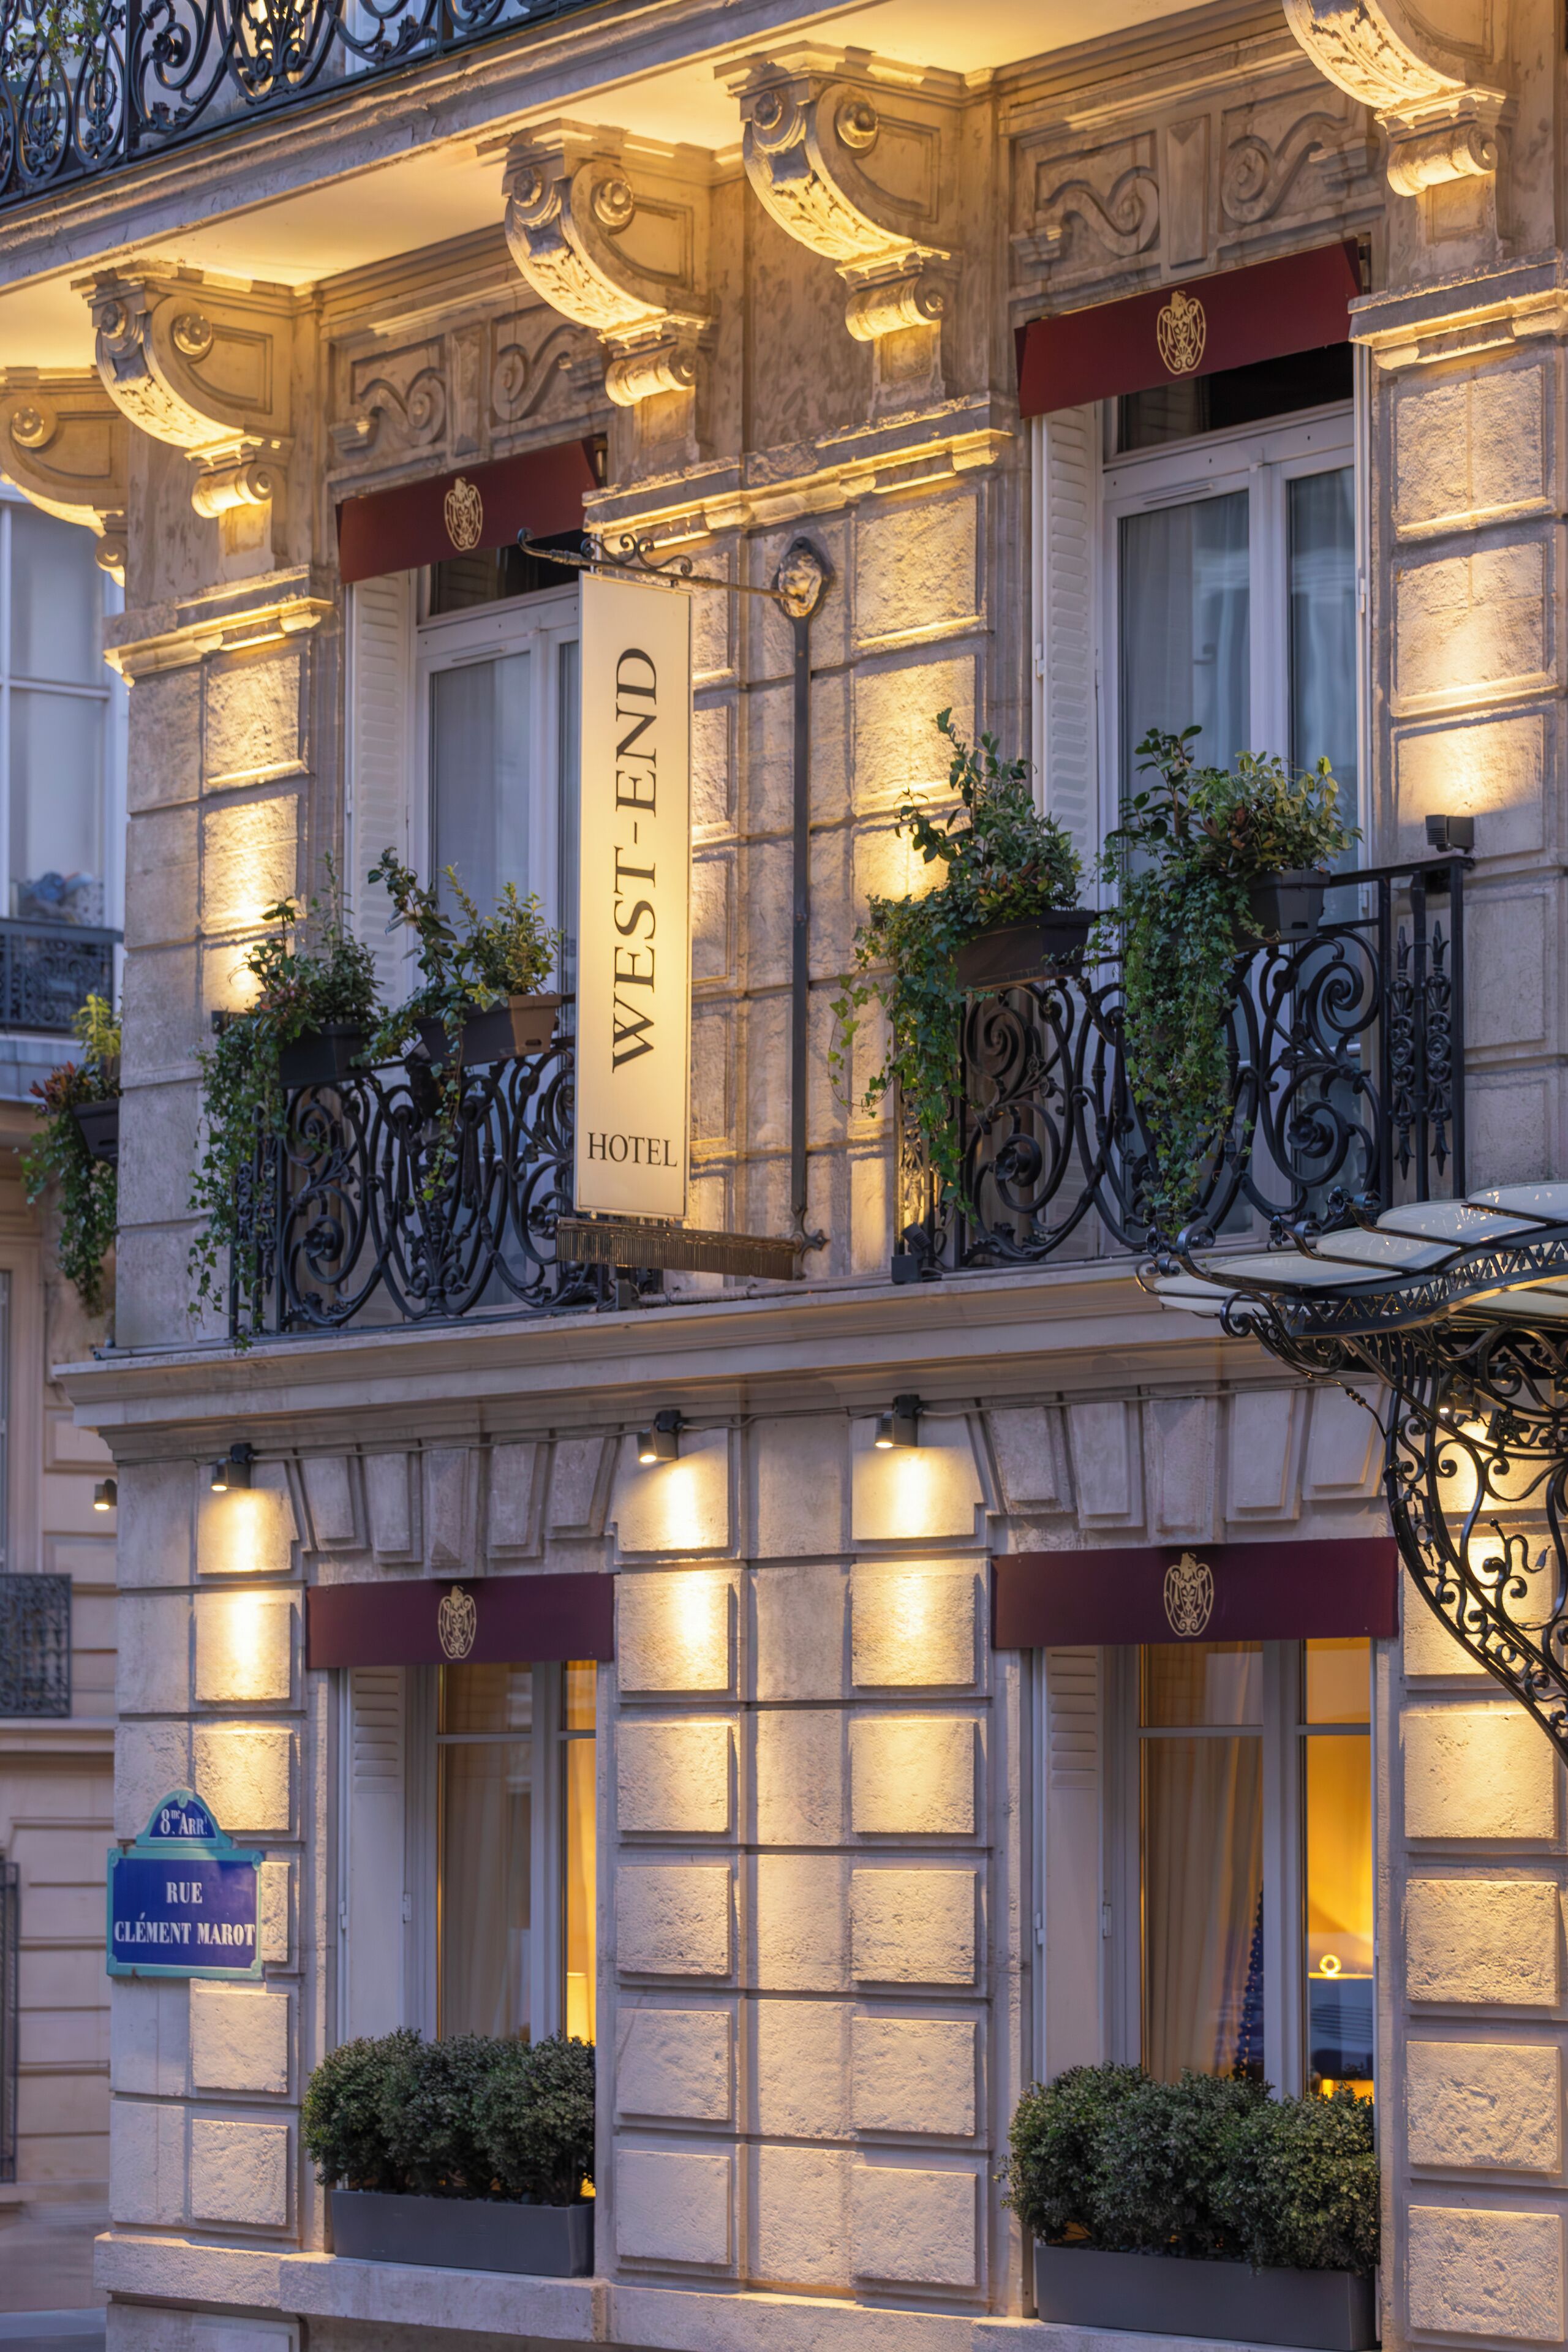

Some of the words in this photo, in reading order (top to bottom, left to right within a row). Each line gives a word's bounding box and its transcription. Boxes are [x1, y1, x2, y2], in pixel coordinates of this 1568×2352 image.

[612, 647, 657, 1073] WEST-END
[587, 1131, 678, 1167] HOTEL
[166, 1882, 203, 1904] RUE
[115, 1912, 192, 1944] CLÉMENT
[197, 1922, 255, 1946] MAROT
